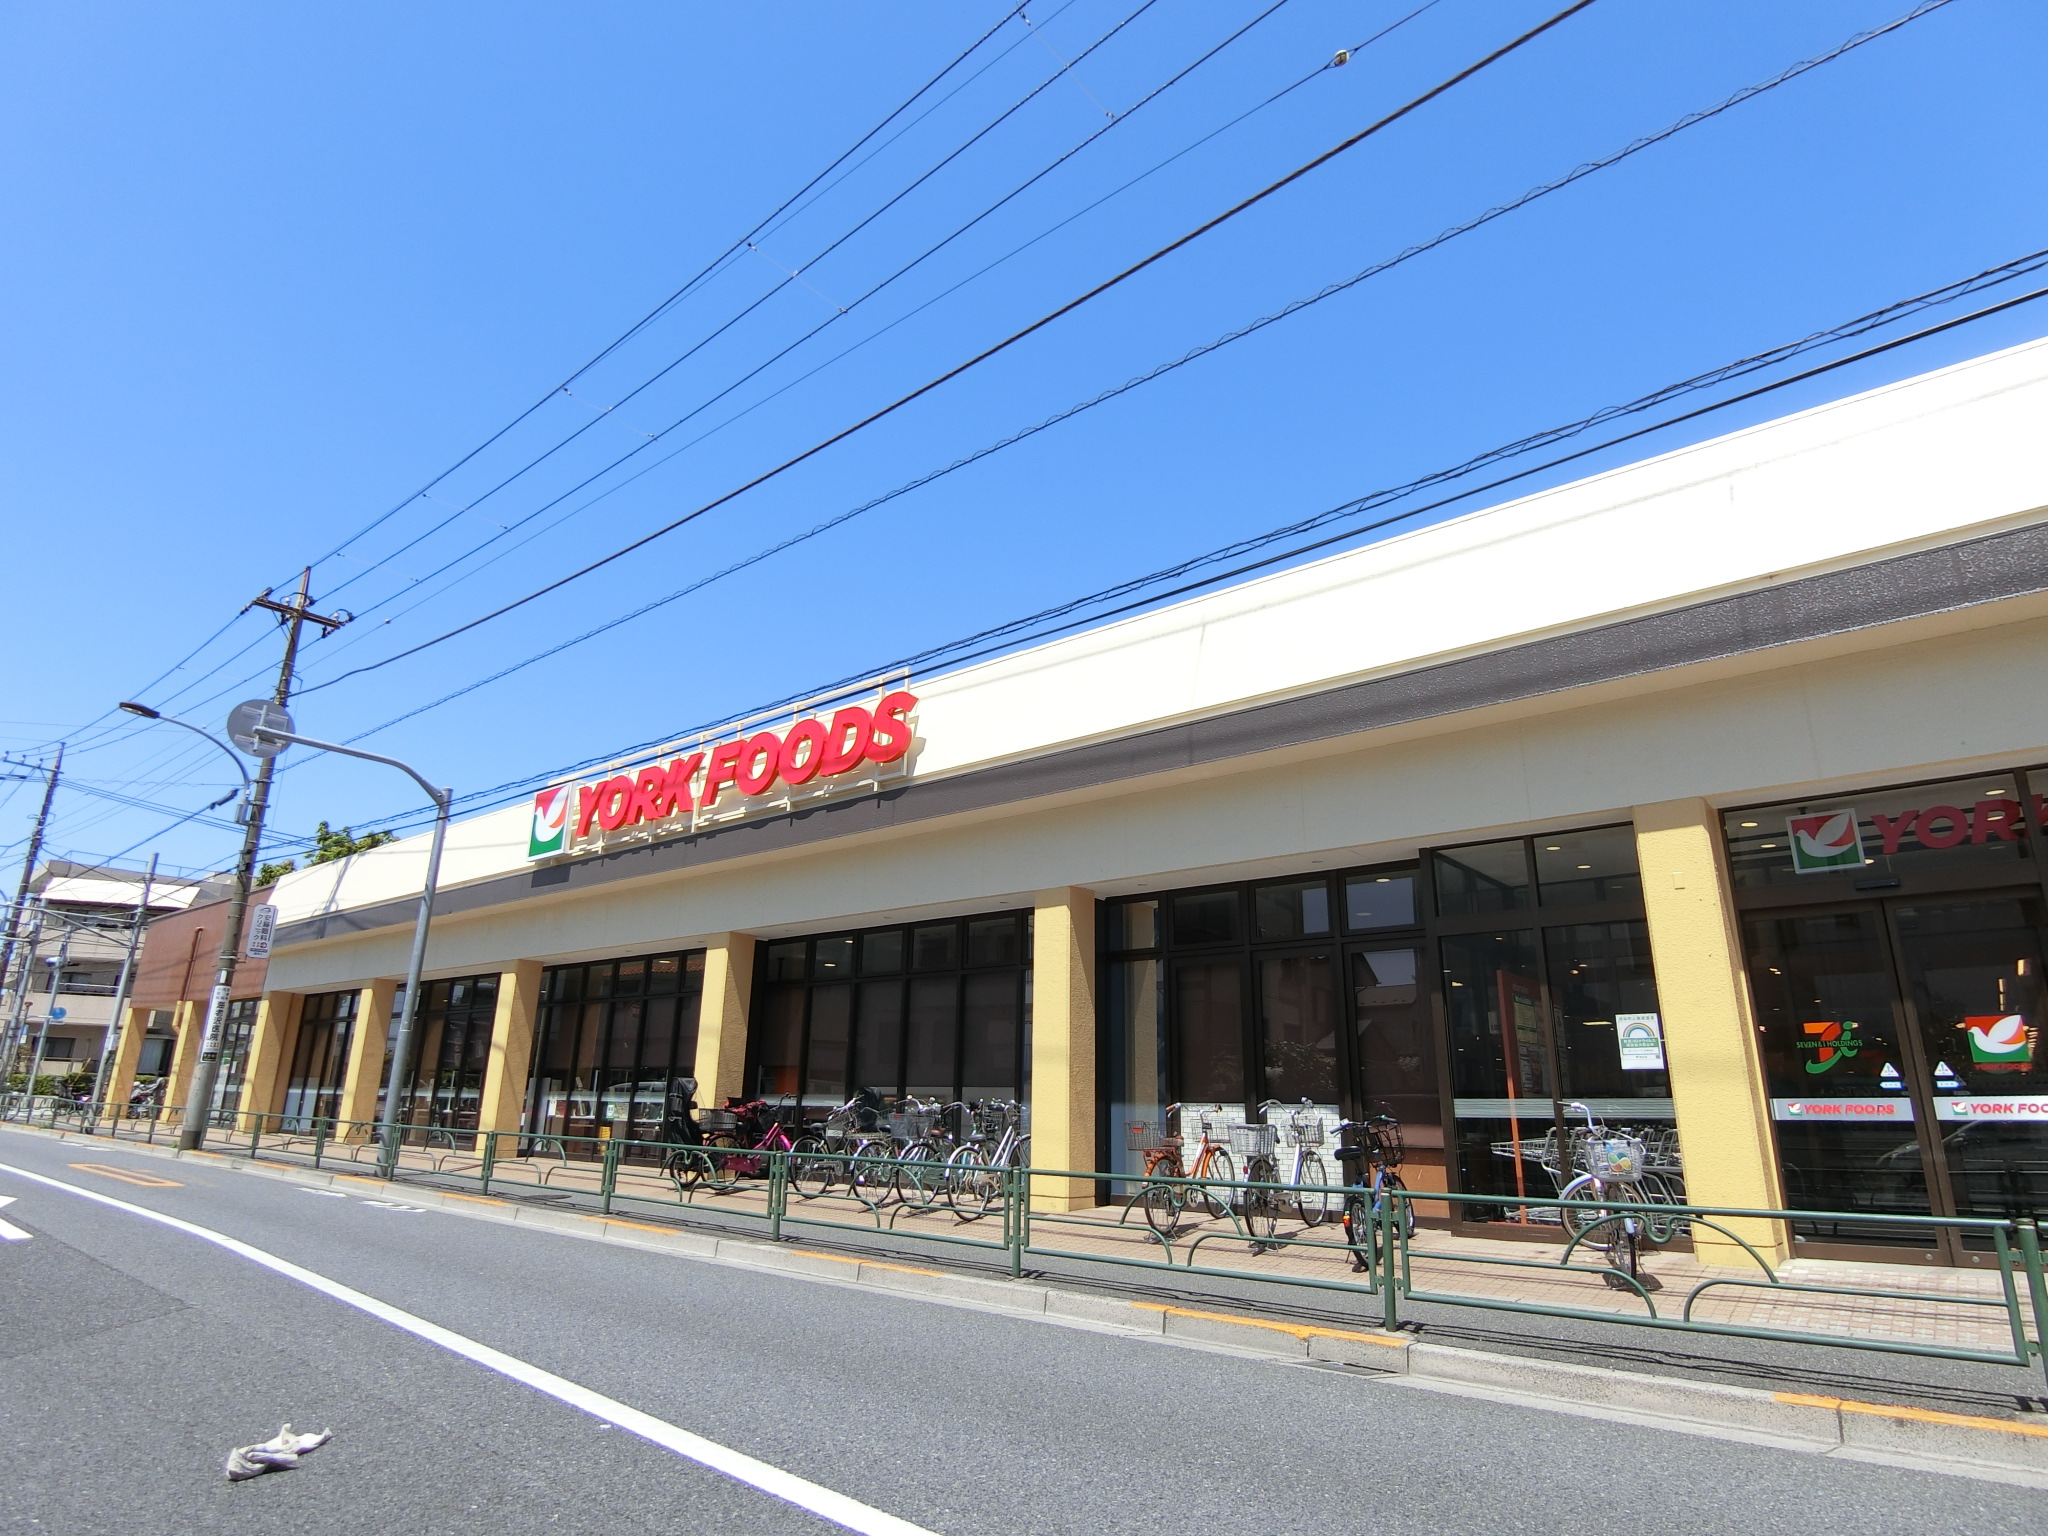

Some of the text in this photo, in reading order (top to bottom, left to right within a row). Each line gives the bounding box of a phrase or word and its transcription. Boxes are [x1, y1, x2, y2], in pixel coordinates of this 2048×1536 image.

[574, 691, 920, 838] YORK FOODS
[1804, 1103, 1895, 1115] YORK FOODS
[1970, 1103, 2014, 1114] YORK
